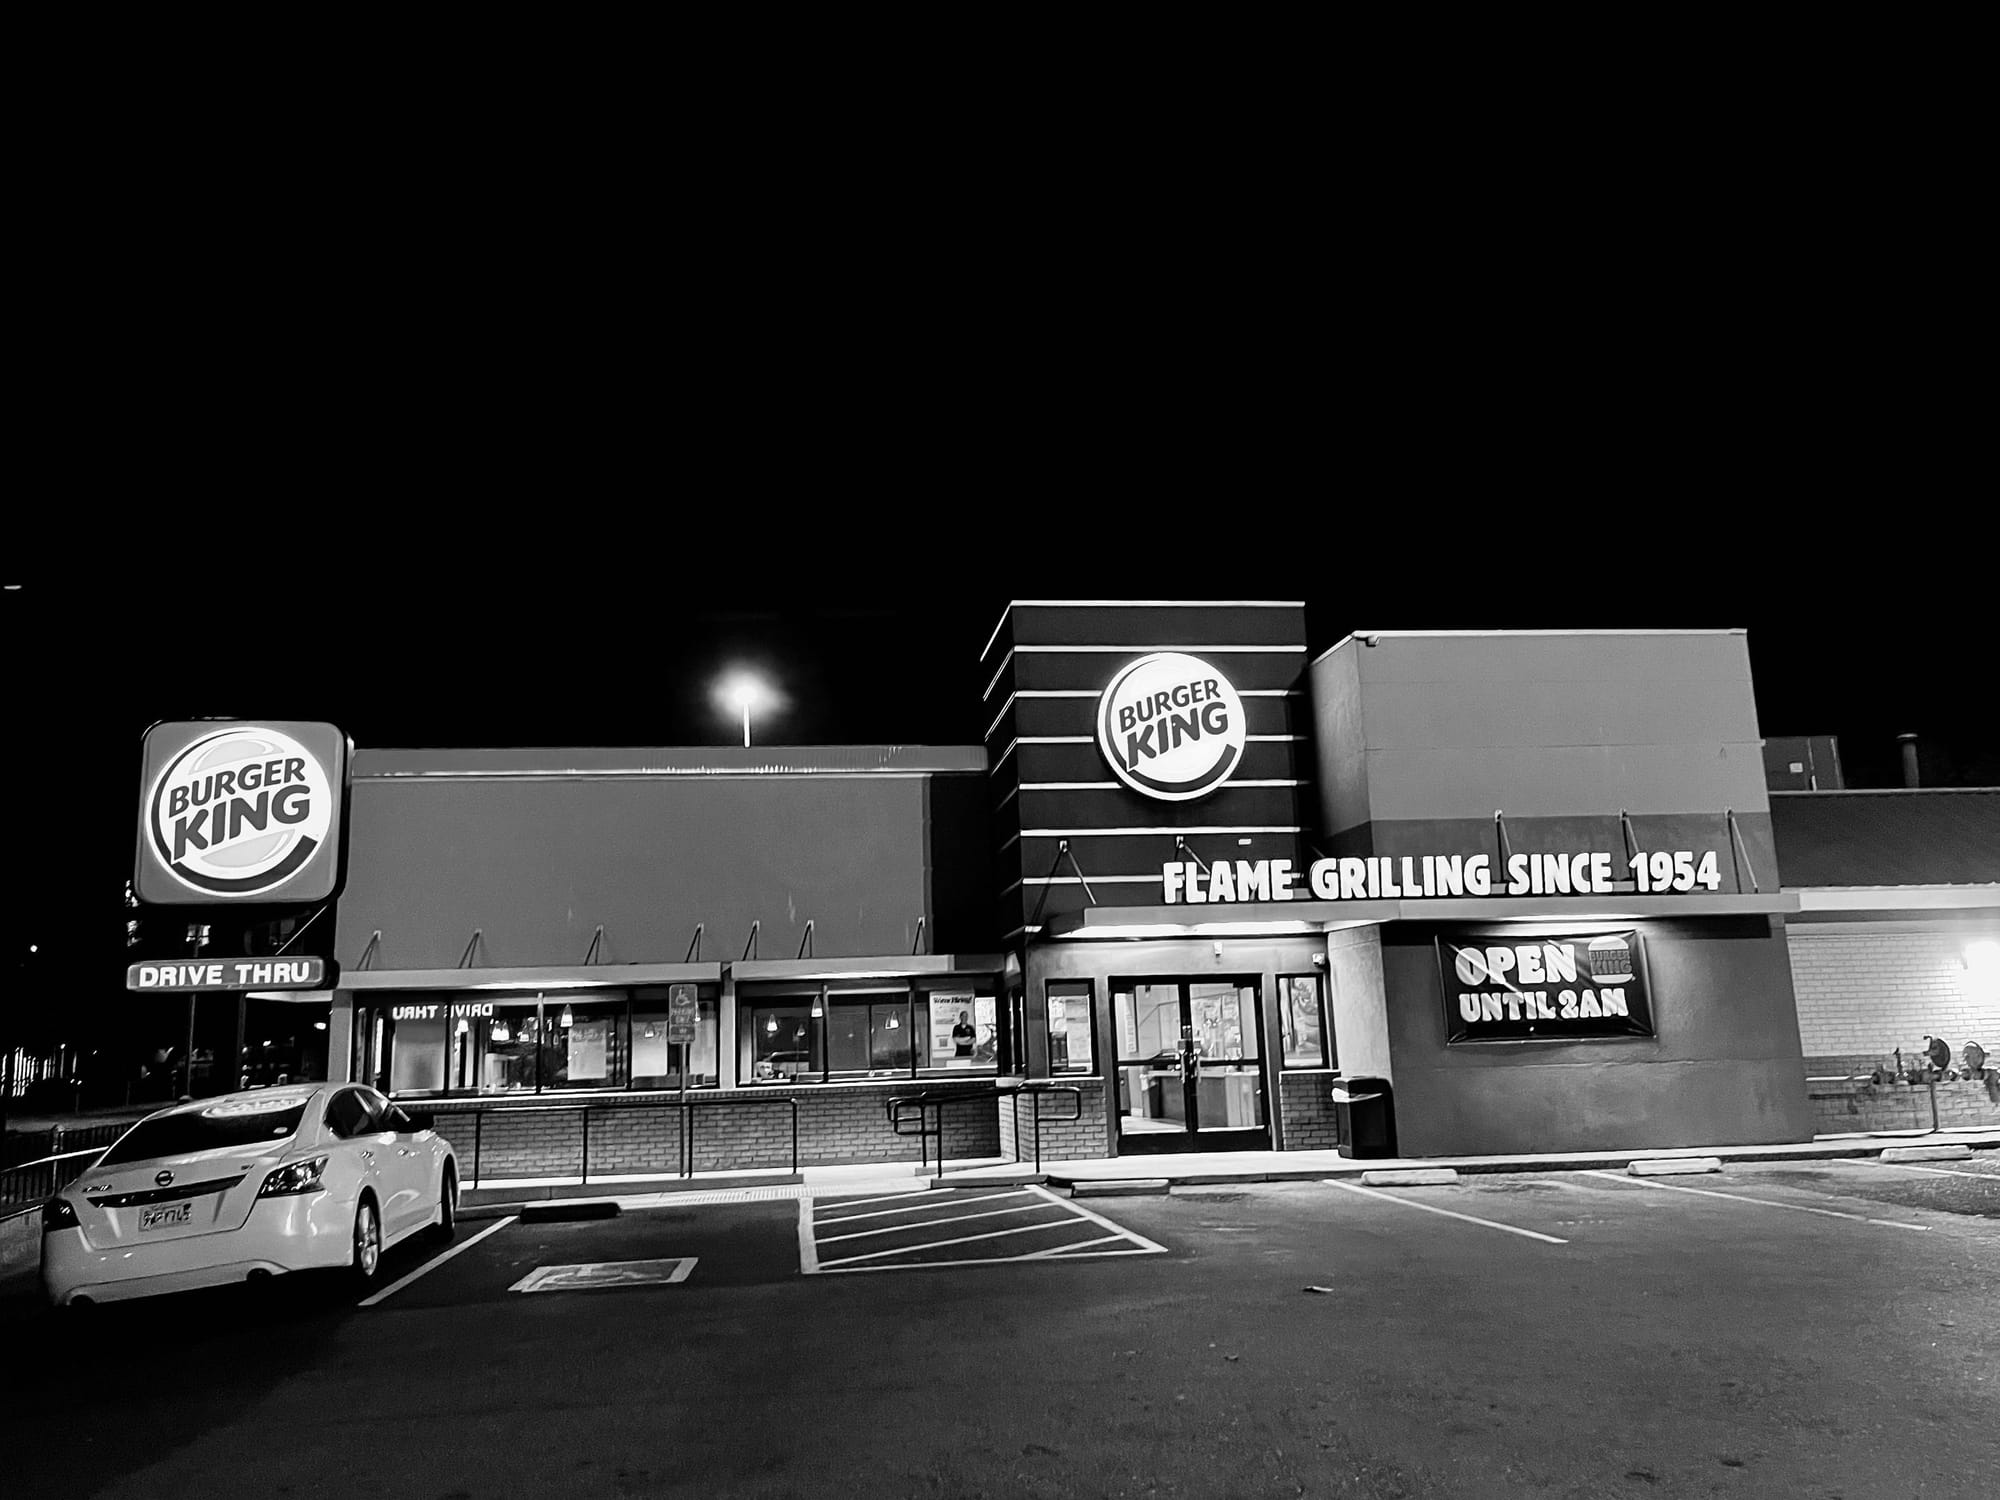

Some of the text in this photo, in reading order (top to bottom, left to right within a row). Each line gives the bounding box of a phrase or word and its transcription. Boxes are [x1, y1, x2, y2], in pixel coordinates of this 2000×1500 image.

[1118, 679, 1222, 733] BURGER
[1127, 701, 1229, 769] KING
[169, 757, 306, 818] BURGER
[173, 784, 311, 861] KING
[1163, 851, 1721, 904] FLAME GRILLING SINCE 1954
[139, 961, 310, 988] DRIVE THRU
[1455, 944, 1578, 986] OPEN
[1590, 961, 1633, 975] KING
[1458, 988, 1630, 1023] UNTIL 2AM
